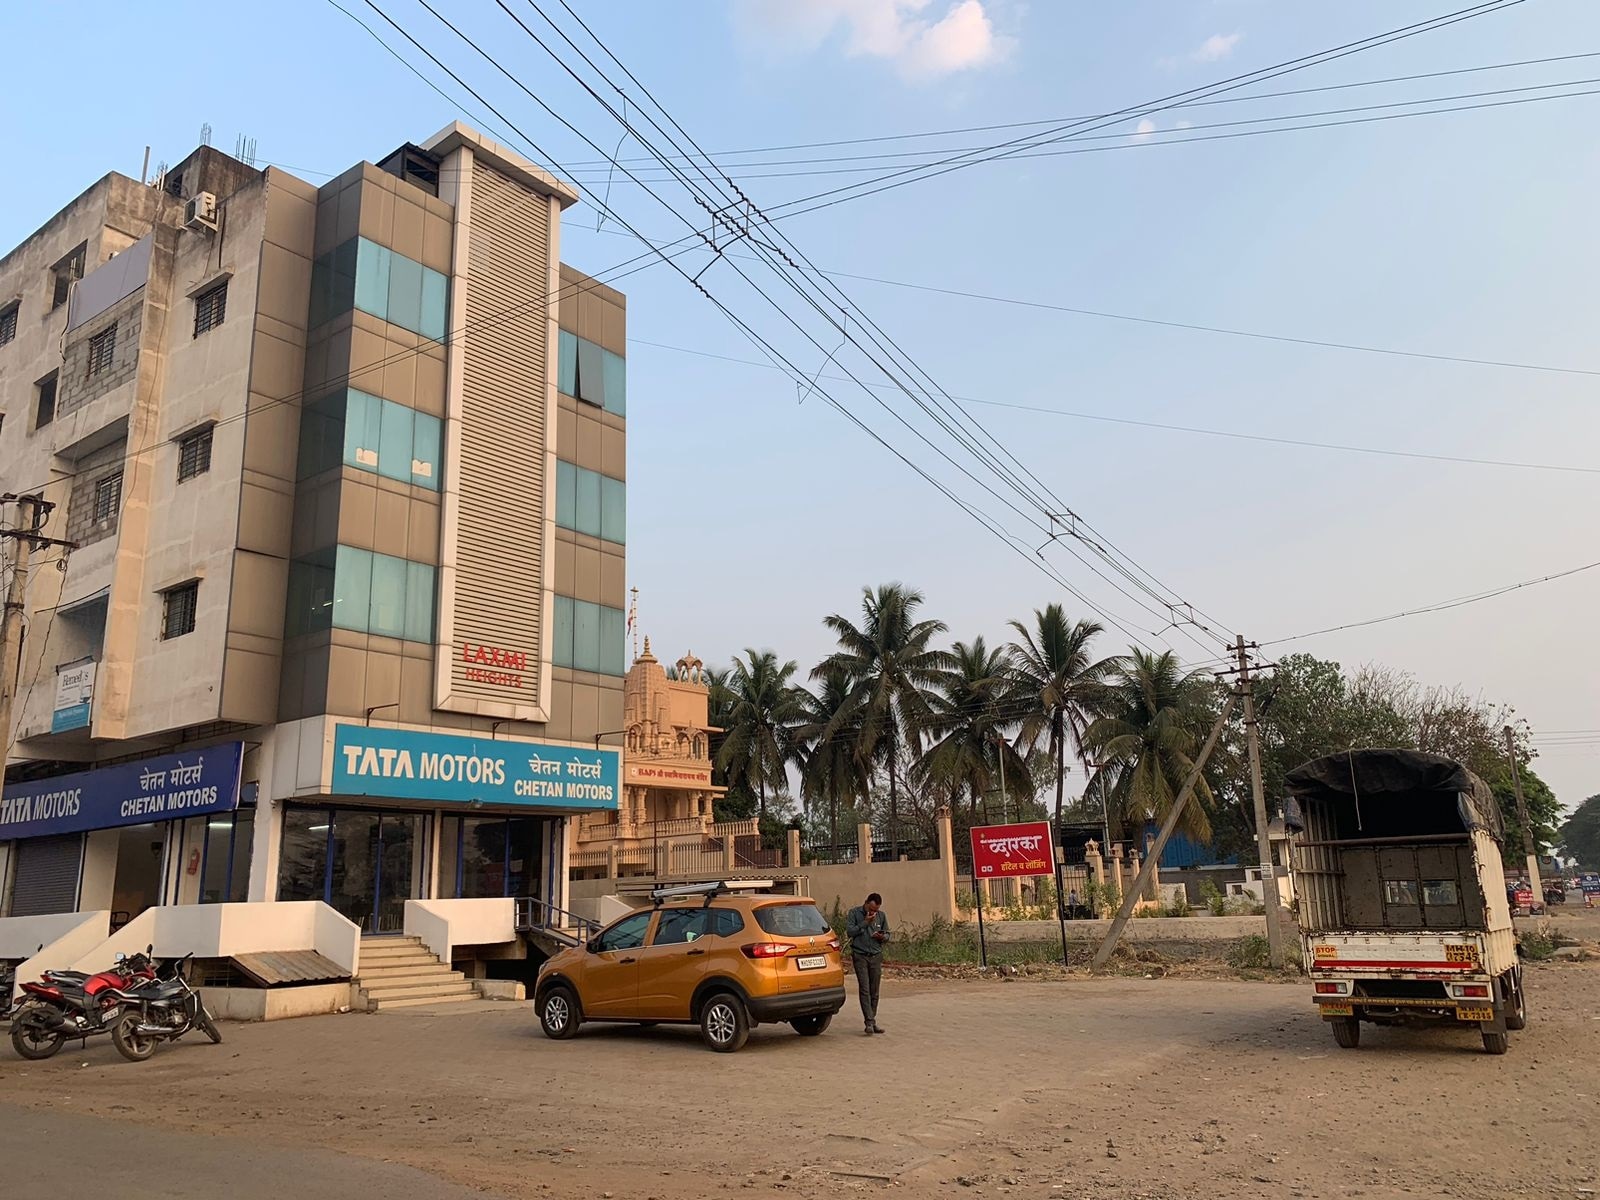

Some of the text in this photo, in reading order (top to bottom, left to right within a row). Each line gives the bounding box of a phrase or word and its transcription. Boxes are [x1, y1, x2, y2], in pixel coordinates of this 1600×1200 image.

[463, 642, 526, 670] LAXMI
[466, 668, 522, 688] HEIGHTS
[140, 756, 204, 791] चेतन मोटर्स
[343, 745, 505, 785] TATA MOTORS
[529, 753, 602, 779] चेतन मोटर्स
[121, 785, 218, 817] CHETAN MOTORS
[514, 779, 613, 801] CHETAN MOTORS
[0, 788, 82, 824] TATA MOTORS
